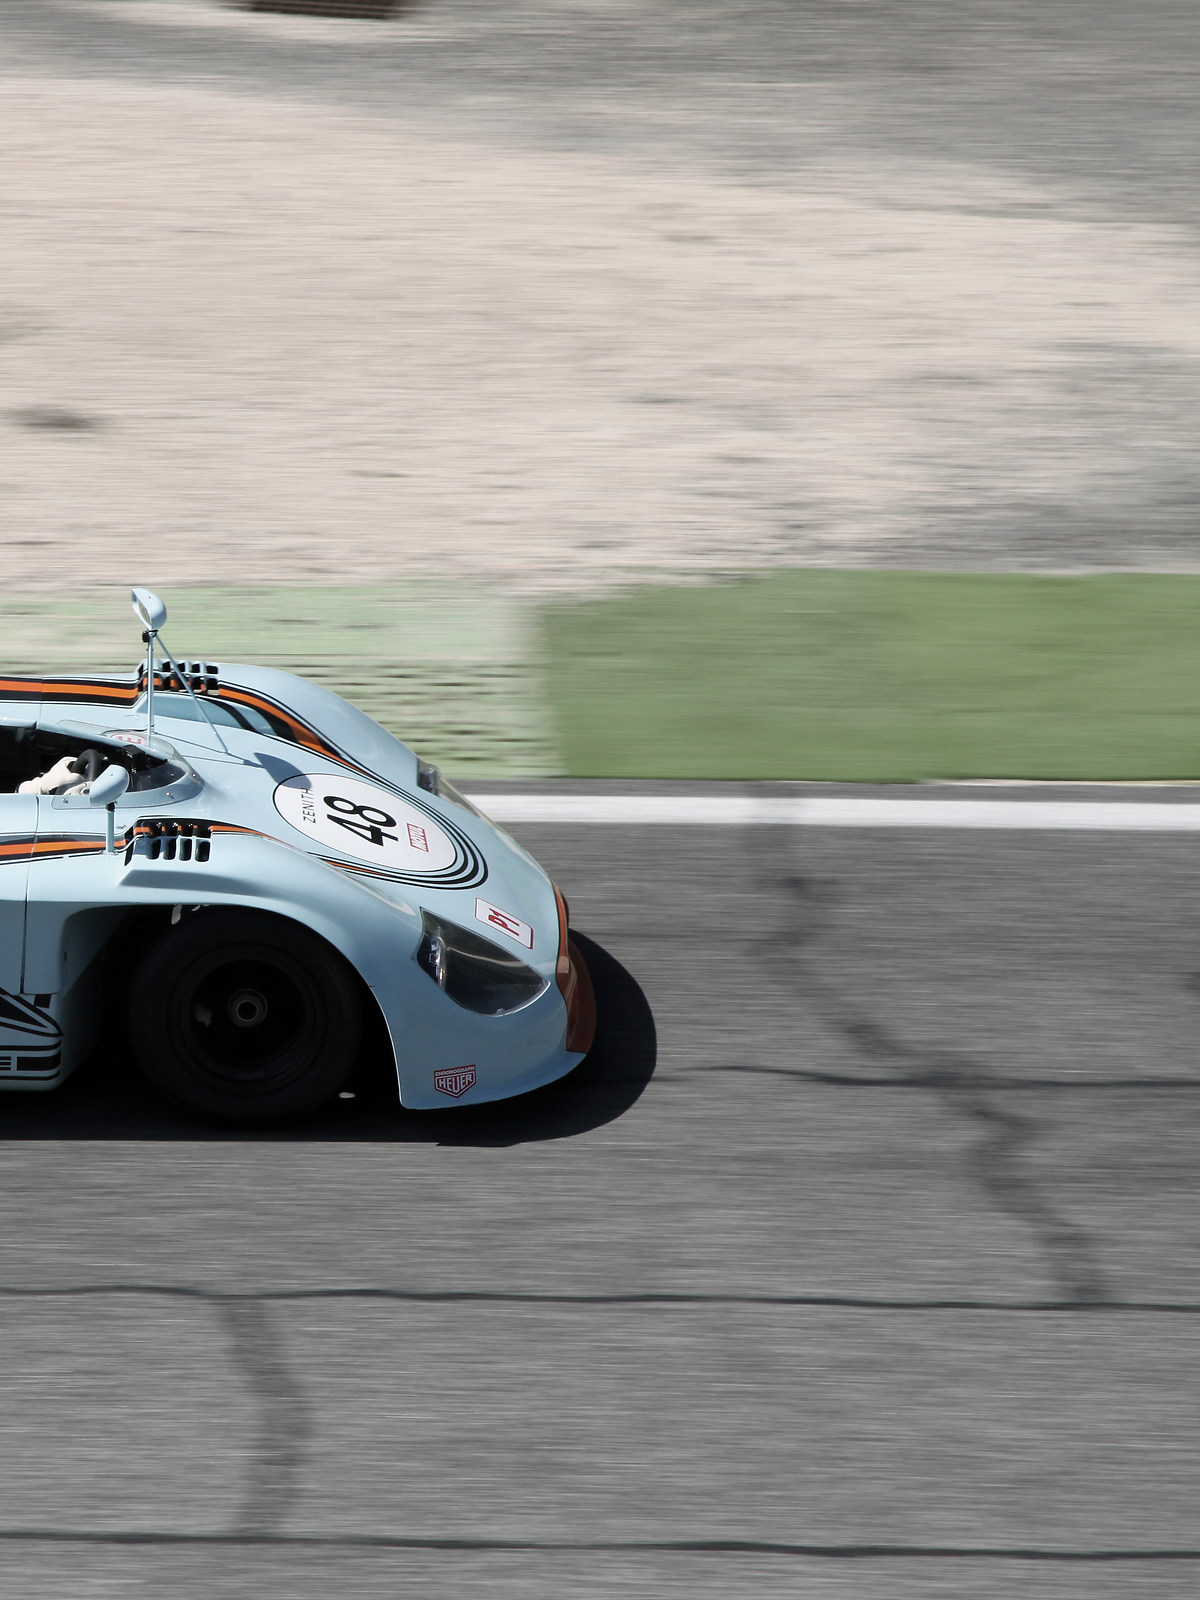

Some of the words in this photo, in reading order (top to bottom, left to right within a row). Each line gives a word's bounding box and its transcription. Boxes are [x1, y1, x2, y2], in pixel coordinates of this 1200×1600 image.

[301, 788, 316, 823] ZENITH
[323, 795, 399, 847] 48
[408, 824, 428, 852] MOTUL
[488, 908, 520, 936] P1
[434, 1065, 475, 1077] CHRONOGRAPH
[438, 1074, 473, 1093] HEUER
